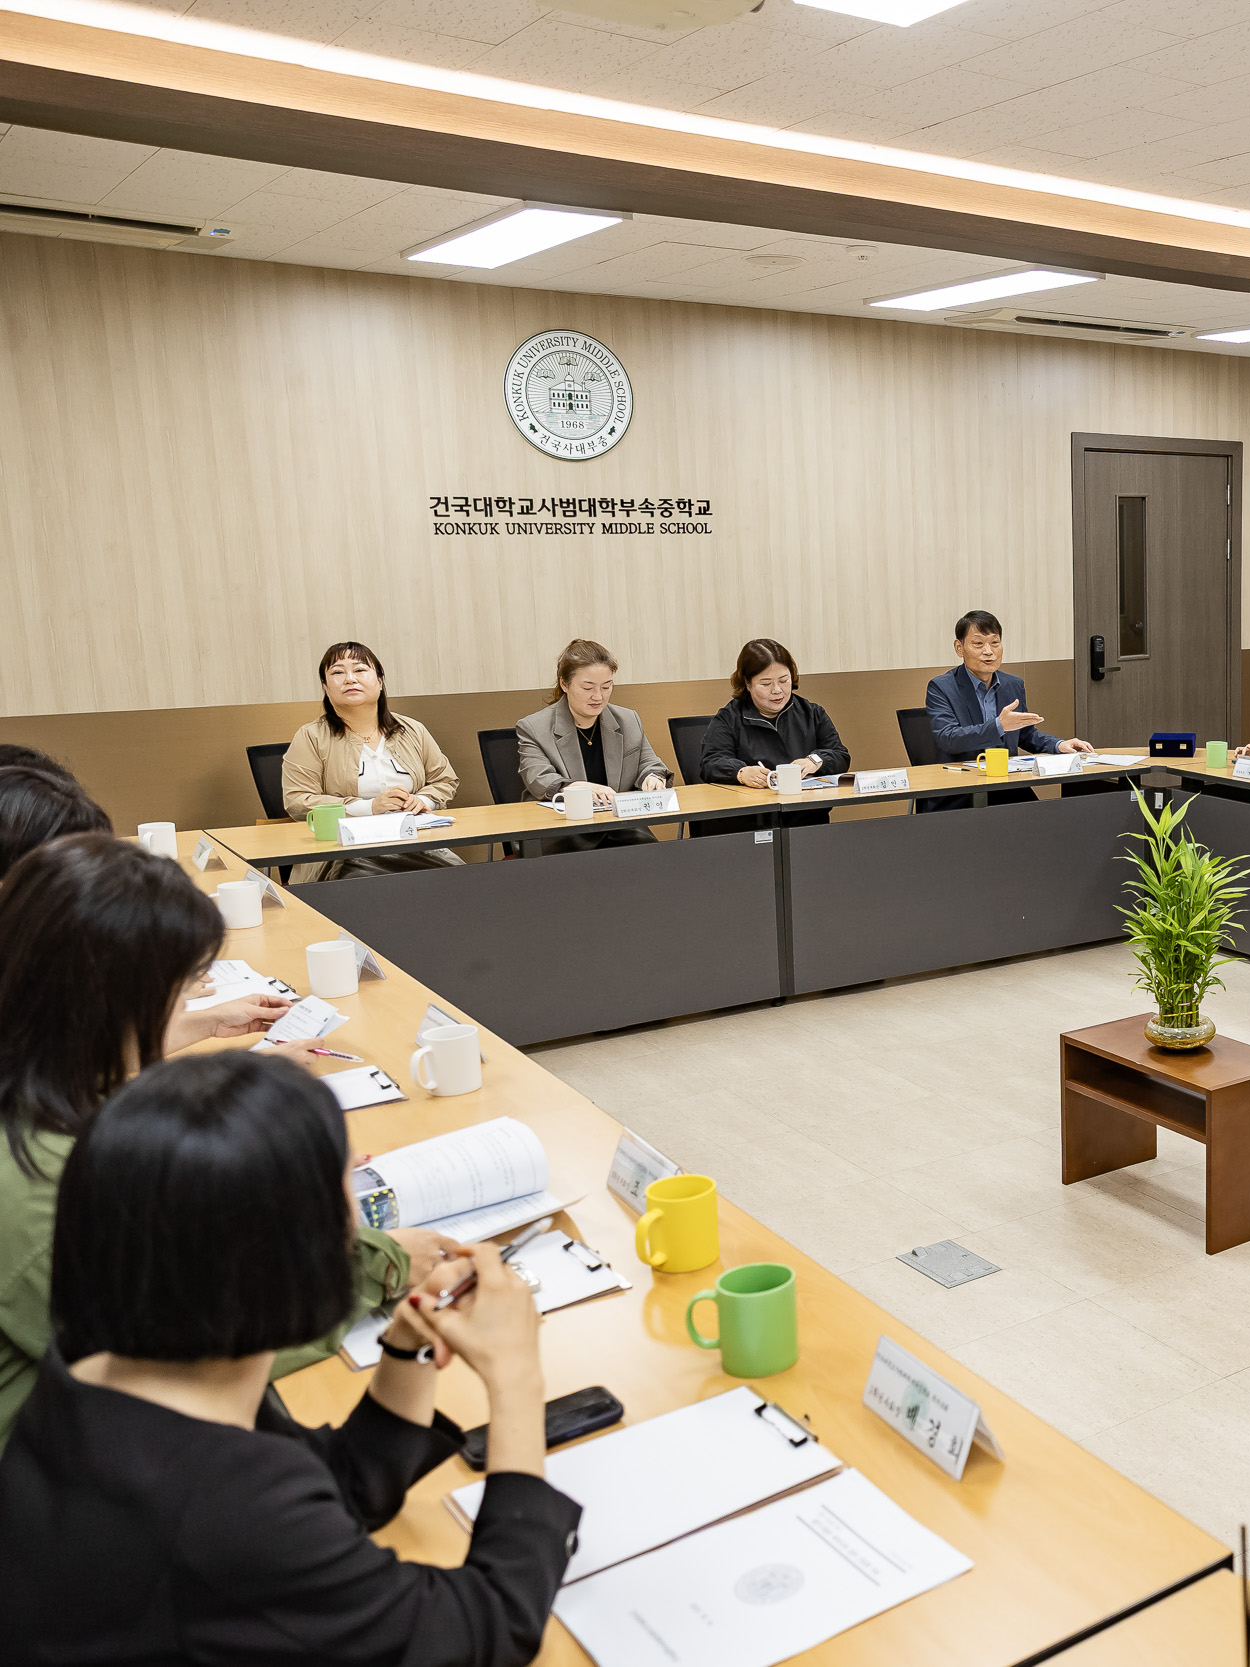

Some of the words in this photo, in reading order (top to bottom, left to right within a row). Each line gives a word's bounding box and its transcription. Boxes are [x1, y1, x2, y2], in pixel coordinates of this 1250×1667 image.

[517, 336, 579, 370] UNIVERSITY
[581, 340, 620, 379] MIDDLE
[512, 370, 529, 423] KONKUK
[613, 380, 627, 424] SCHOOL
[560, 420, 585, 429] 1968
[540, 433, 608, 455] 건국사대부중
[429, 496, 713, 518] 건국대학교사범대학부속중학교
[434, 522, 500, 535] KONKUK
[506, 522, 596, 535] UNIVERSITY
[601, 522, 655, 535] MIDDLE
[659, 522, 713, 535] SCHOOL
